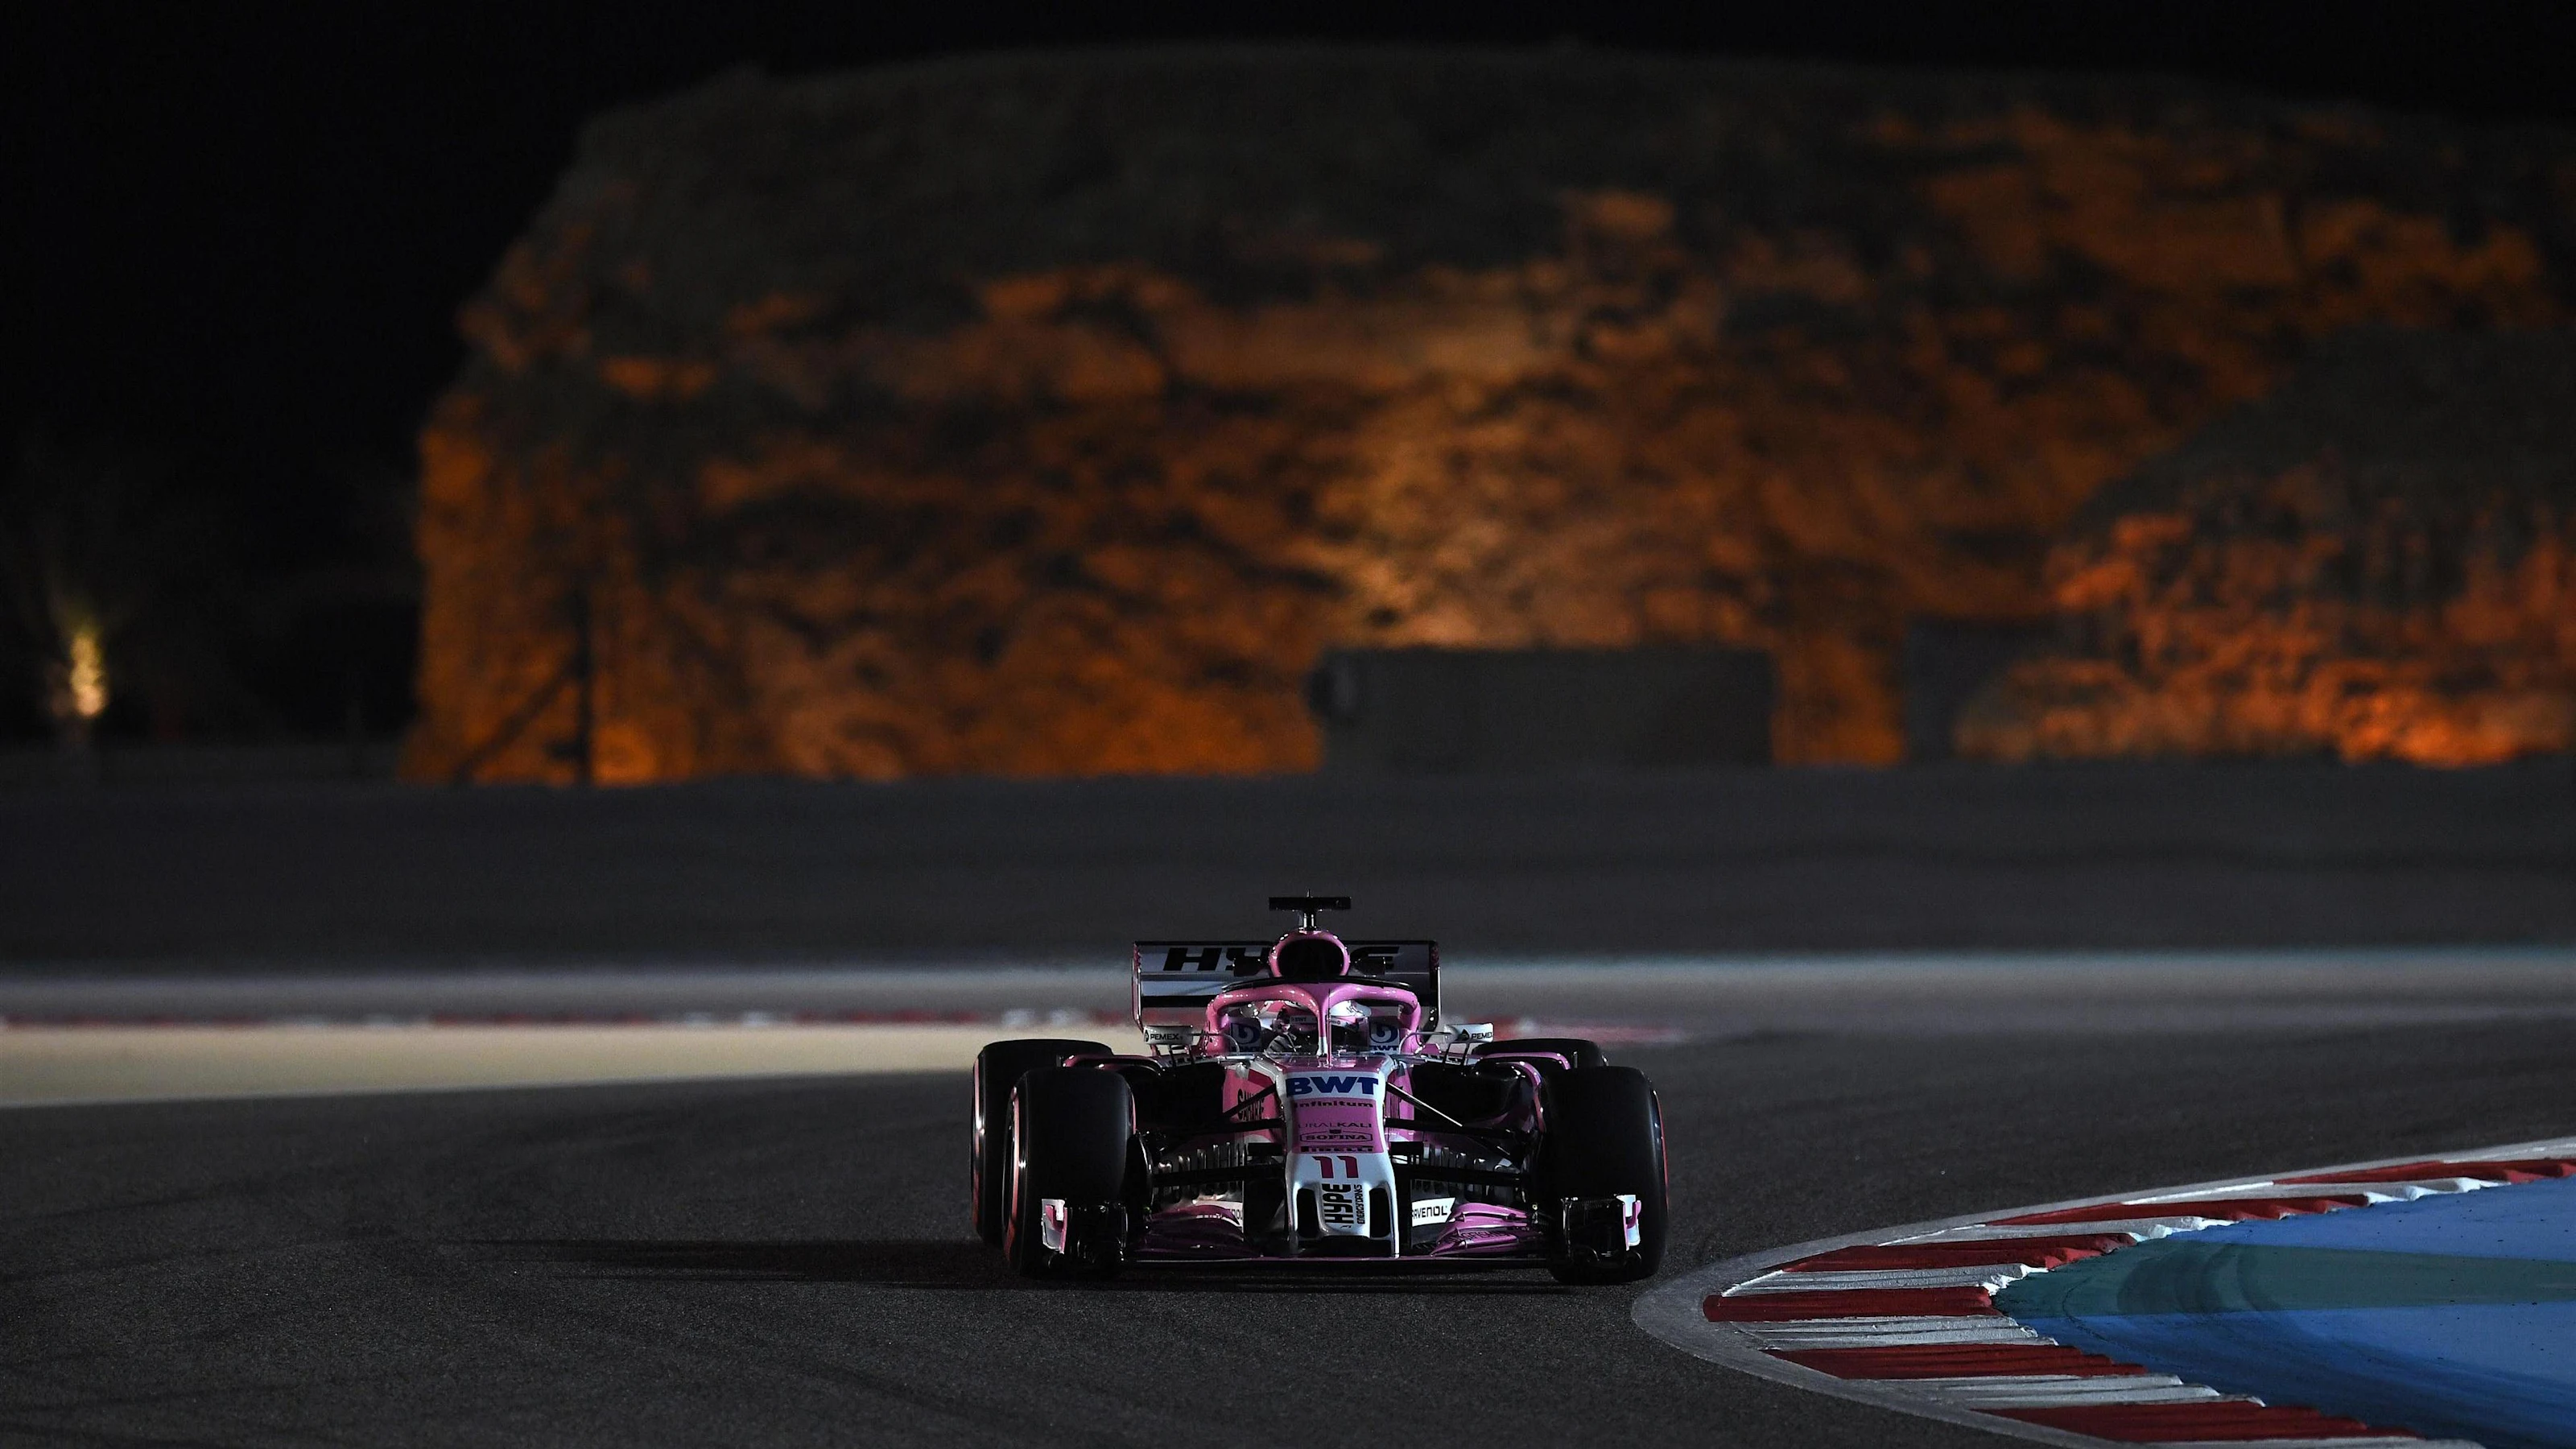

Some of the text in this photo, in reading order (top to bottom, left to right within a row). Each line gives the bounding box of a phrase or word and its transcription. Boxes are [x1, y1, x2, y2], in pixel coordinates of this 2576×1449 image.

[1163, 947, 1400, 971] HYE
[1286, 1076, 1379, 1097] BWT
[1311, 1155, 1359, 1179] 11
[1321, 1183, 1355, 1224] HYPE
